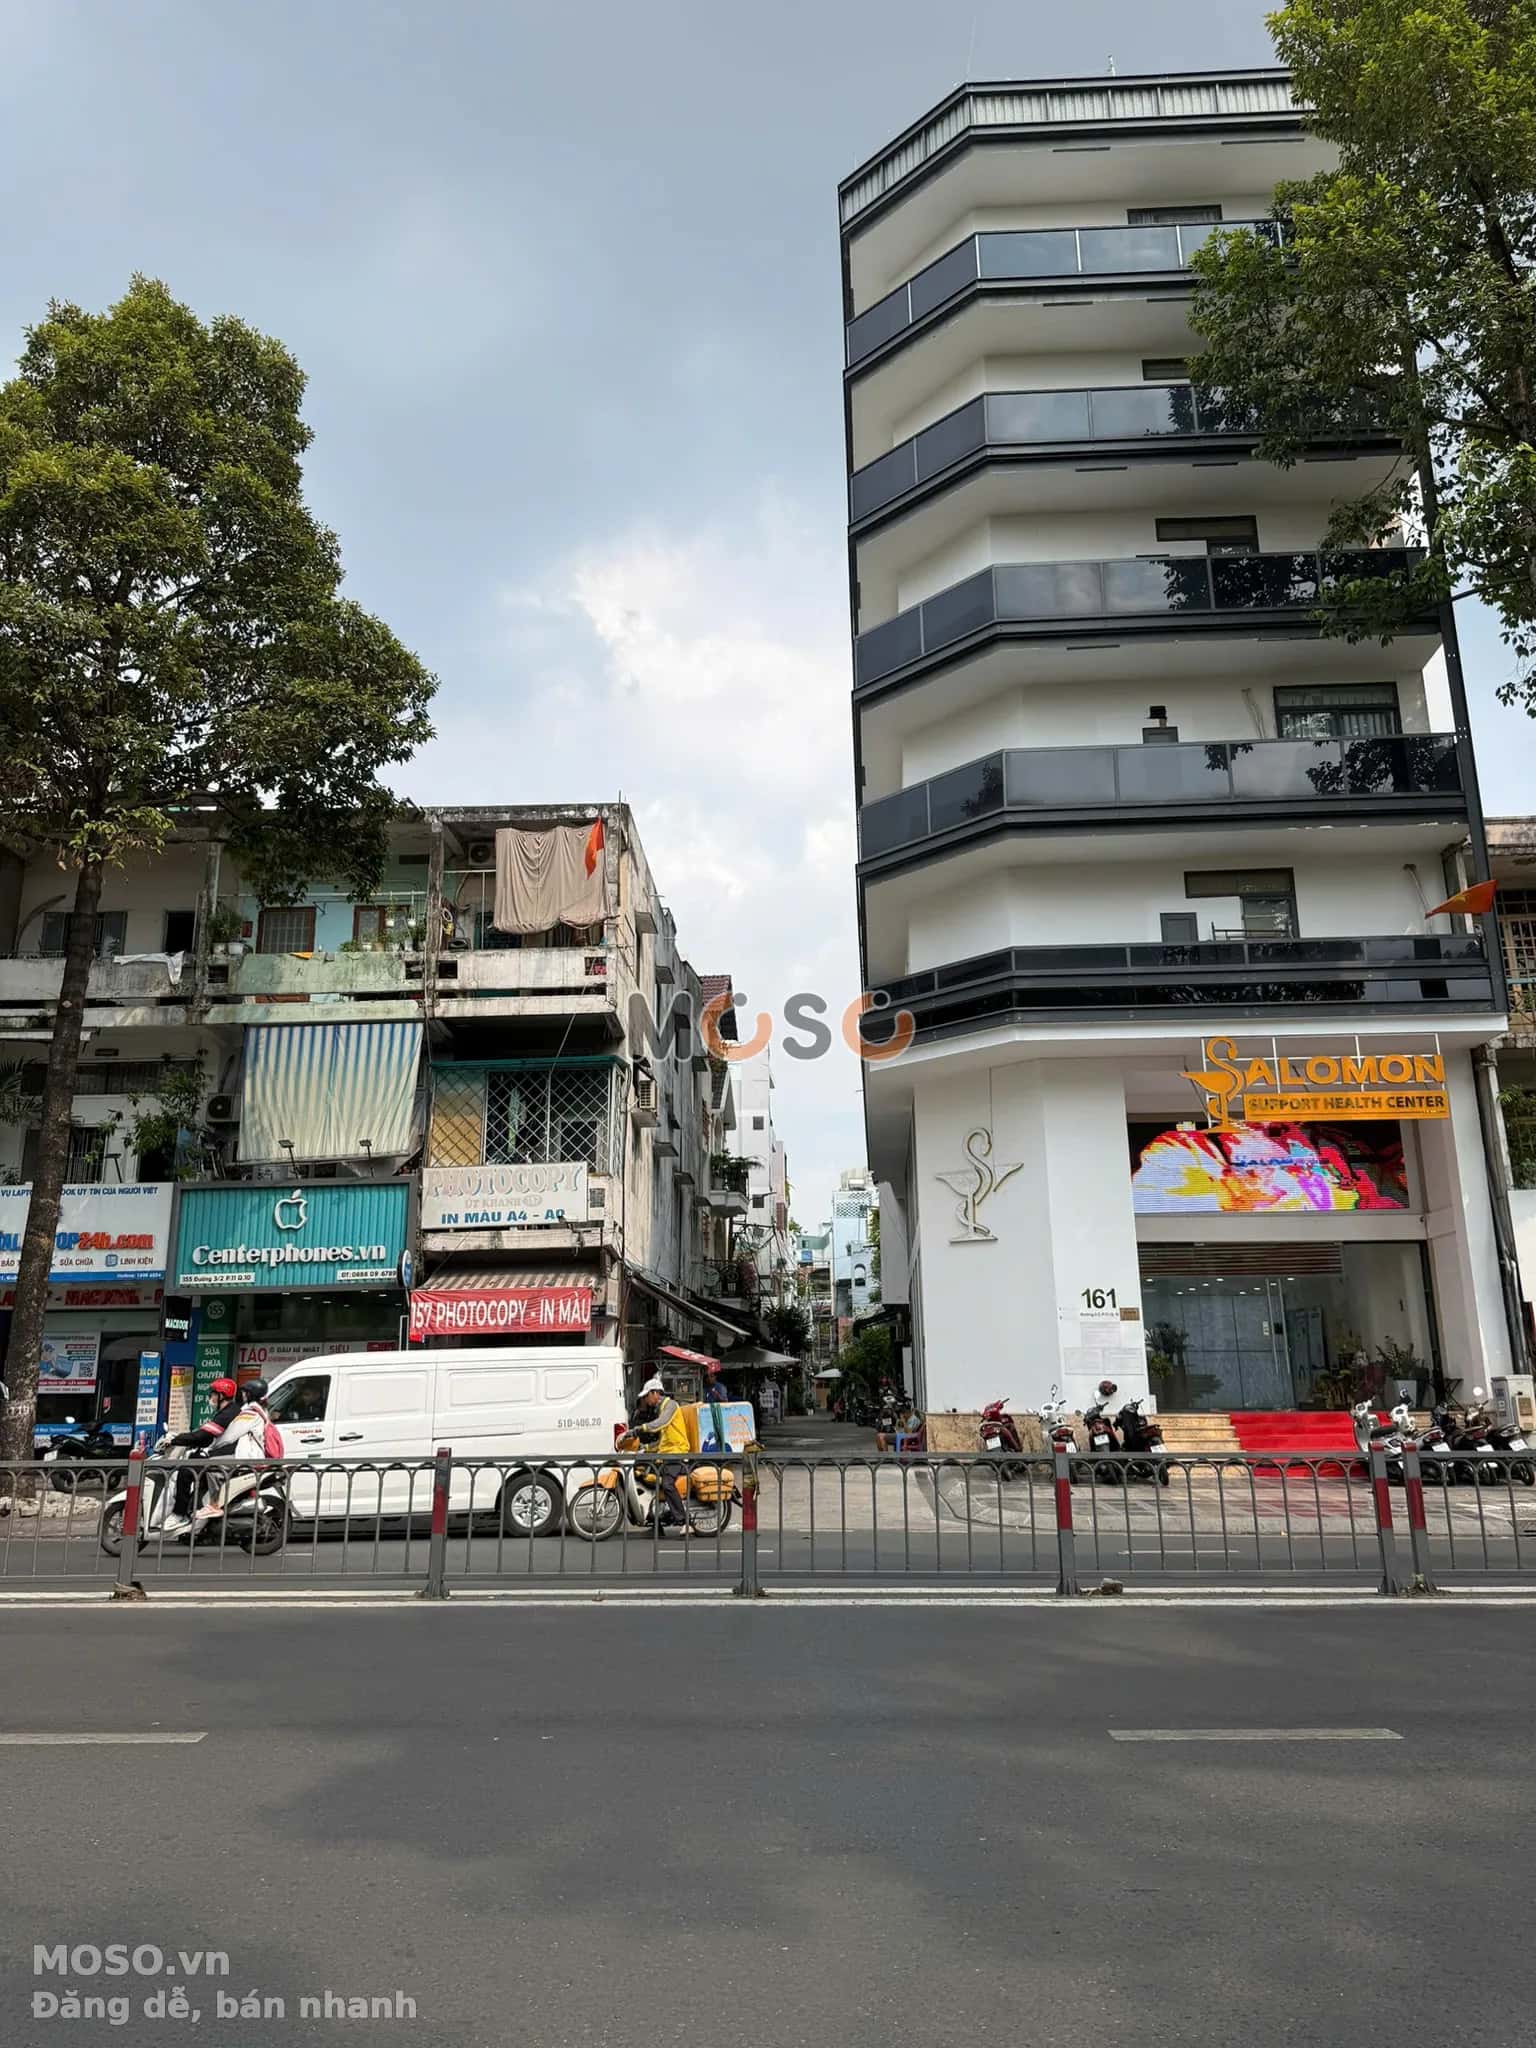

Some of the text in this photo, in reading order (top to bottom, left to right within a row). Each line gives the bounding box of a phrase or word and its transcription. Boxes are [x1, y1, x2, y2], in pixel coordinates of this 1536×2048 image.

[1206, 1037, 1446, 1098] SALOMON
[1249, 1095, 1444, 1111] SUPPORT HEALTH CENTER
[427, 1165, 583, 1197] PHOTOCOPY
[441, 1213, 459, 1225] IN
[506, 1210, 528, 1222] A4
[192, 1243, 386, 1268] Centerphones.vn
[410, 1302, 432, 1328] 157
[436, 1299, 528, 1327] PHOTOCOPY
[539, 1300, 554, 1324] IN
[558, 1291, 591, 1324] MÀU
[1081, 1288, 1116, 1309] 161
